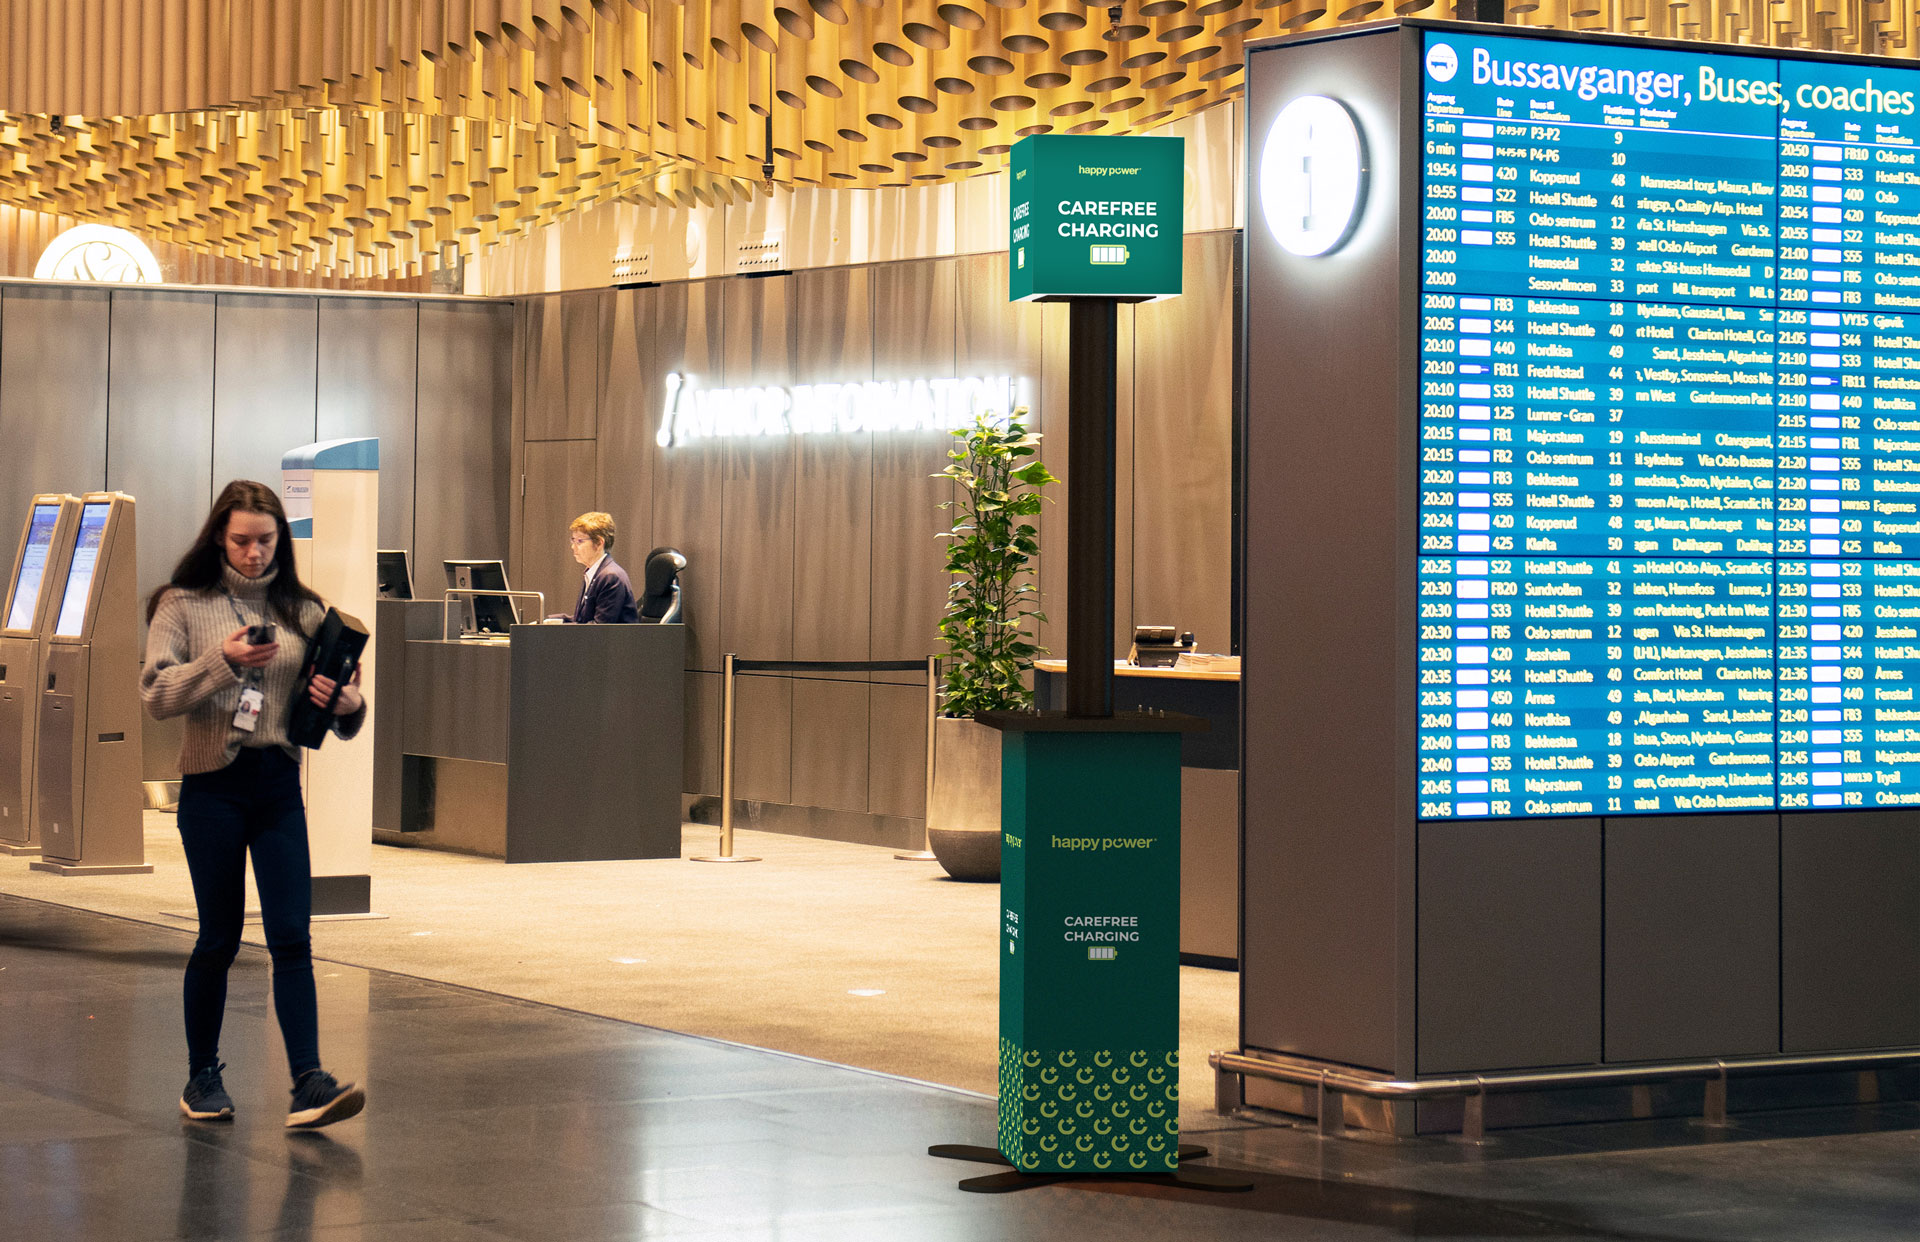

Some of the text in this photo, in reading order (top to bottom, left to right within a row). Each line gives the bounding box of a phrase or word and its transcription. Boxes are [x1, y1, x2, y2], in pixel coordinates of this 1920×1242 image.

[1472, 47, 1915, 114] Bussavganger, Buses, coaches
[1427, 119, 1434, 132] 5
[1434, 121, 1455, 133] min
[1531, 127, 1560, 141] P3-P2
[1615, 132, 1623, 144] 9
[1427, 141, 1434, 154] 6
[1434, 143, 1455, 155] min
[1530, 148, 1559, 162] P4-P6
[1612, 153, 1626, 165] 10
[1078, 165, 1108, 177] happy
[1427, 163, 1457, 176] 19:54
[1496, 167, 1517, 180] 420
[1530, 169, 1580, 185] Kopperud
[1611, 174, 1625, 186] 48
[1844, 168, 1863, 181] S33
[1427, 185, 1456, 199] 19:55
[1496, 189, 1516, 202] S22
[1530, 191, 1561, 205] Hotell
[1561, 193, 1597, 207] Shuttle
[1611, 195, 1624, 208] 41
[1844, 189, 1864, 201] 400
[1057, 200, 1158, 216] CAREFREE
[1844, 209, 1864, 222] 420
[1426, 206, 1457, 220] 20:00
[1529, 213, 1554, 226] Oslo
[1555, 217, 1596, 228] sentrum
[1611, 216, 1625, 229] 12
[1057, 222, 1159, 238] CHARGING
[1426, 228, 1456, 242] 20:00
[1496, 231, 1516, 245] S55
[1529, 234, 1560, 247] Hotell
[1561, 235, 1597, 249] Shuttle
[1611, 237, 1625, 250] 39
[1426, 249, 1456, 263] 20:00
[1529, 255, 1579, 270] Hemsedal
[1611, 259, 1624, 271] 32
[1426, 271, 1456, 285] 20:00
[1611, 280, 1624, 292] 33
[1425, 295, 1455, 309] 20:00
[1528, 300, 1579, 314] Bekkestua
[1610, 303, 1623, 316] 18
[1424, 338, 1455, 352] 20:10
[1494, 341, 1515, 354] 440
[1609, 345, 1623, 358] 49
[1424, 360, 1455, 374] 20:10
[1528, 364, 1584, 379] Fredrikstad
[1609, 367, 1623, 379] 44
[1842, 396, 1862, 408] 440
[1424, 404, 1454, 418] 20:10
[1494, 406, 1514, 419] 125
[1528, 408, 1562, 421] Lunner
[1569, 409, 1594, 422] Gran
[1609, 409, 1623, 422] 37
[1424, 426, 1454, 440] 20:15
[1527, 429, 1584, 445] Majorstuen
[1609, 431, 1623, 443] 19
[1423, 536, 1453, 549] 20:25
[1492, 536, 1513, 550] 425
[1608, 537, 1622, 550] 50
[1421, 582, 1452, 595] 20:30
[1608, 582, 1621, 595] 32
[1843, 625, 1863, 638] 420
[1421, 646, 1622, 661] 20:30 420 Jessheim 50
[1843, 667, 1863, 679] 450
[1421, 692, 1452, 705] 20:36
[1491, 691, 1512, 704] 450
[1607, 690, 1622, 703] 49
[1421, 736, 1452, 750] 20:40
[1525, 735, 1577, 748] Bekkestua
[1608, 733, 1622, 746] 18
[1422, 802, 1451, 817] 20:45
[1525, 800, 1550, 814] Oslo
[1550, 801, 1592, 813] sentrum
[1608, 798, 1621, 811] 11
[1051, 834, 1099, 851] happy
[1064, 916, 1138, 927] CAREFREE
[1064, 931, 1139, 942] CHARGING
